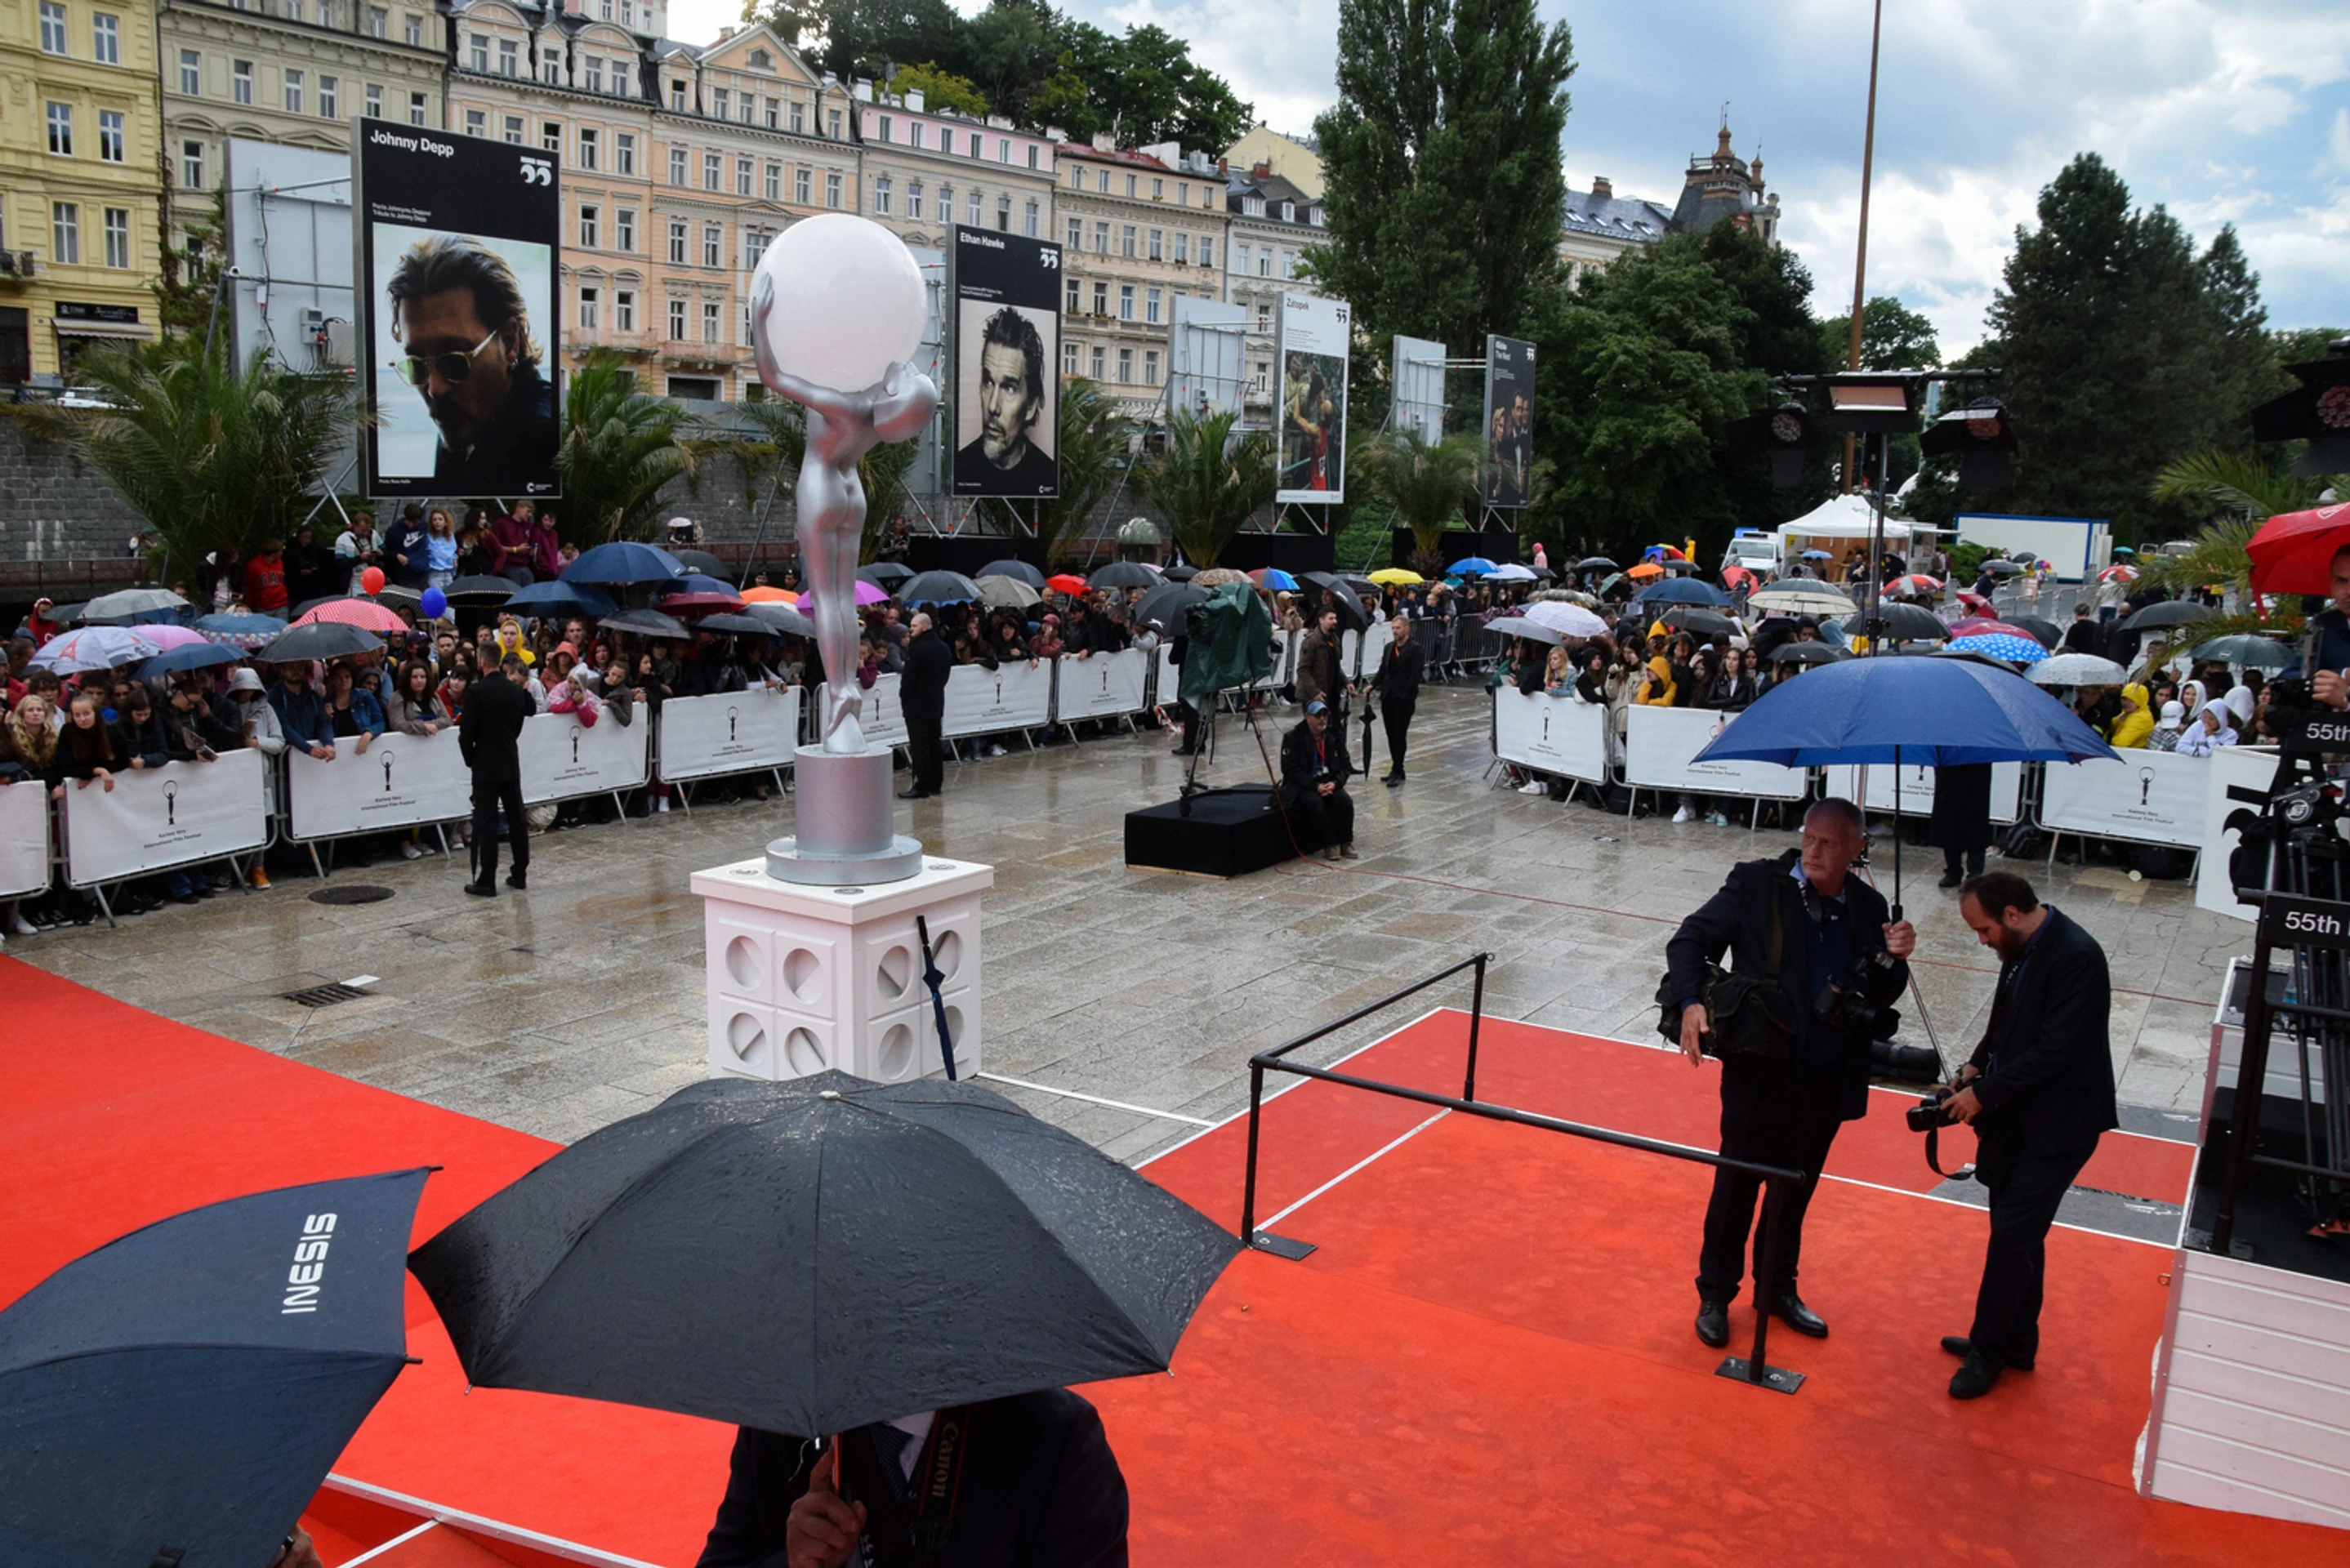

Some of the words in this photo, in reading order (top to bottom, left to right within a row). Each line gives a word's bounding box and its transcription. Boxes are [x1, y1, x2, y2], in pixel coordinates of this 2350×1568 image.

[370, 129, 418, 152] Johnny
[421, 137, 454, 158] Depp
[960, 231, 981, 245] Ethan
[981, 235, 1005, 249] Hawke
[2306, 723, 2350, 742] 55th
[2285, 911, 2341, 935] 55th
[281, 1213, 337, 1314] INESIS
[932, 1422, 959, 1497] Canon
